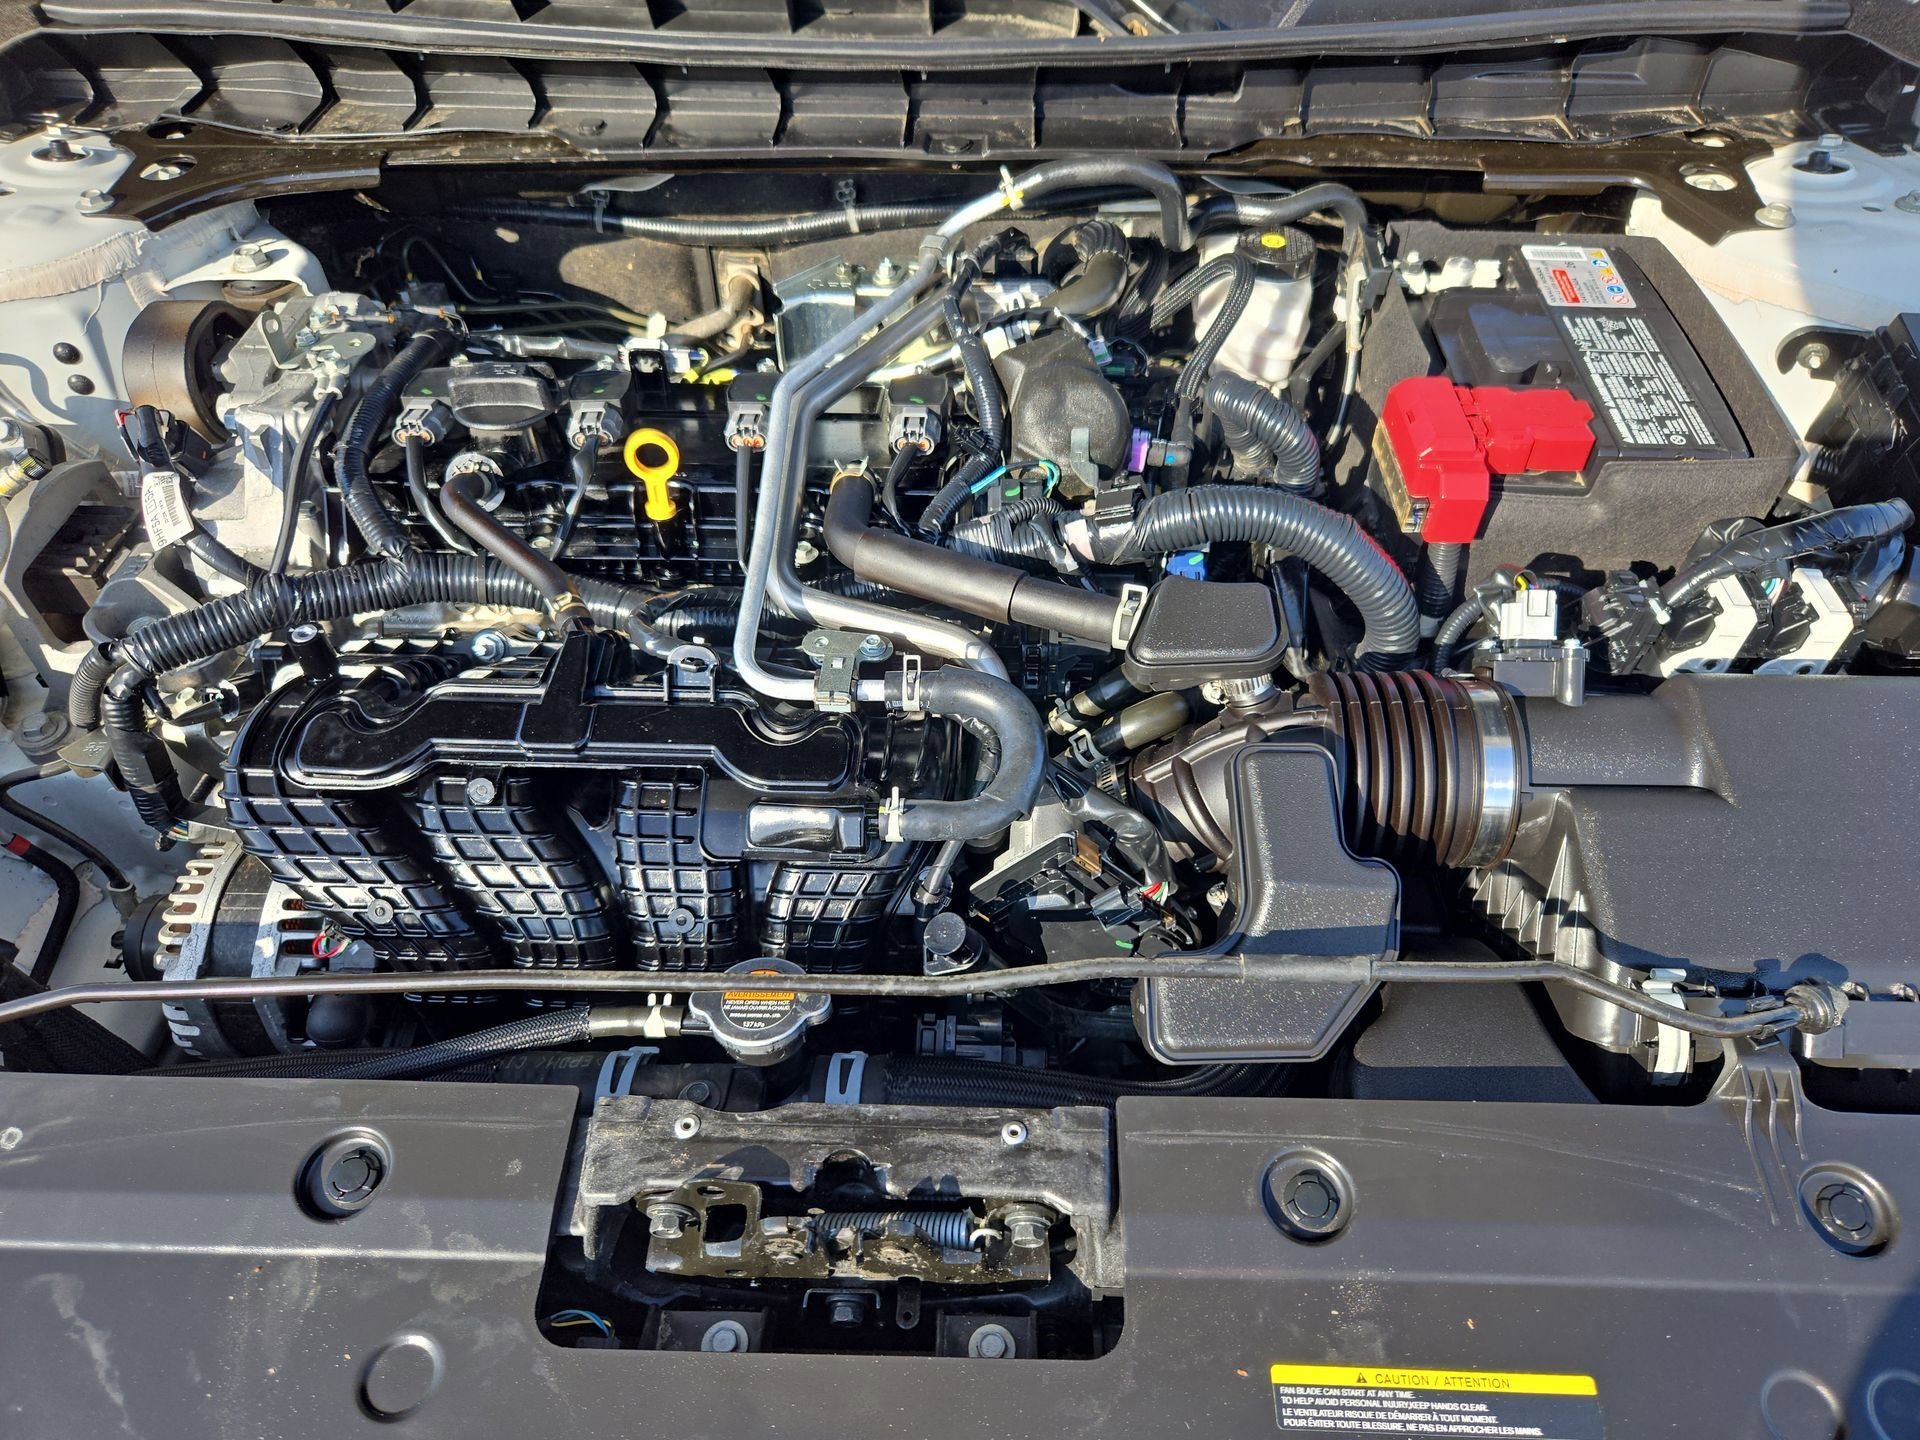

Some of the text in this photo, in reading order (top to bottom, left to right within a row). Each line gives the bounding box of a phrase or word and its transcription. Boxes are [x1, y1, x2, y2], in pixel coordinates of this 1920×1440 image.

[1375, 1373, 1511, 1389] CAUTION / ATTENTION
[1280, 1386, 1295, 1395] FAN
[1296, 1387, 1322, 1396] BLADE
[1323, 1388, 1340, 1396] CAN
[1341, 1388, 1366, 1397] START
[1367, 1389, 1377, 1397] AT
[1378, 1389, 1394, 1398] ANY
[1281, 1396, 1292, 1404] TO
[1294, 1396, 1314, 1405] HELP
[1315, 1397, 1339, 1406] AVOID
[1340, 1398, 1382, 1408] PERSONAL
[1431, 1402, 1459, 1411] HANDS
[1460, 1402, 1489, 1412] CLEAR.
[1282, 1408, 1292, 1416] LE
[1294, 1408, 1343, 1418] VENTILATEUR
[1345, 1410, 1374, 1419] RISQUE
[1376, 1411, 1387, 1419] DE
[1388, 1410, 1432, 1421] DÉMARRER
[1433, 1411, 1440, 1422] À
[1440, 1414, 1461, 1422] TOUT
[1284, 1418, 1307, 1427] POUR
[1308, 1417, 1335, 1428] ÉVITER
[1335, 1420, 1361, 1429] TOUTE
[1362, 1421, 1406, 1431] BLESSURE,
[1406, 1422, 1418, 1431] NE
[1419, 1423, 1435, 1432] PAS
[1436, 1424, 1448, 1433] EN
[1449, 1425, 1499, 1434] APPROCHER
[1500, 1426, 1514, 1434] LES
